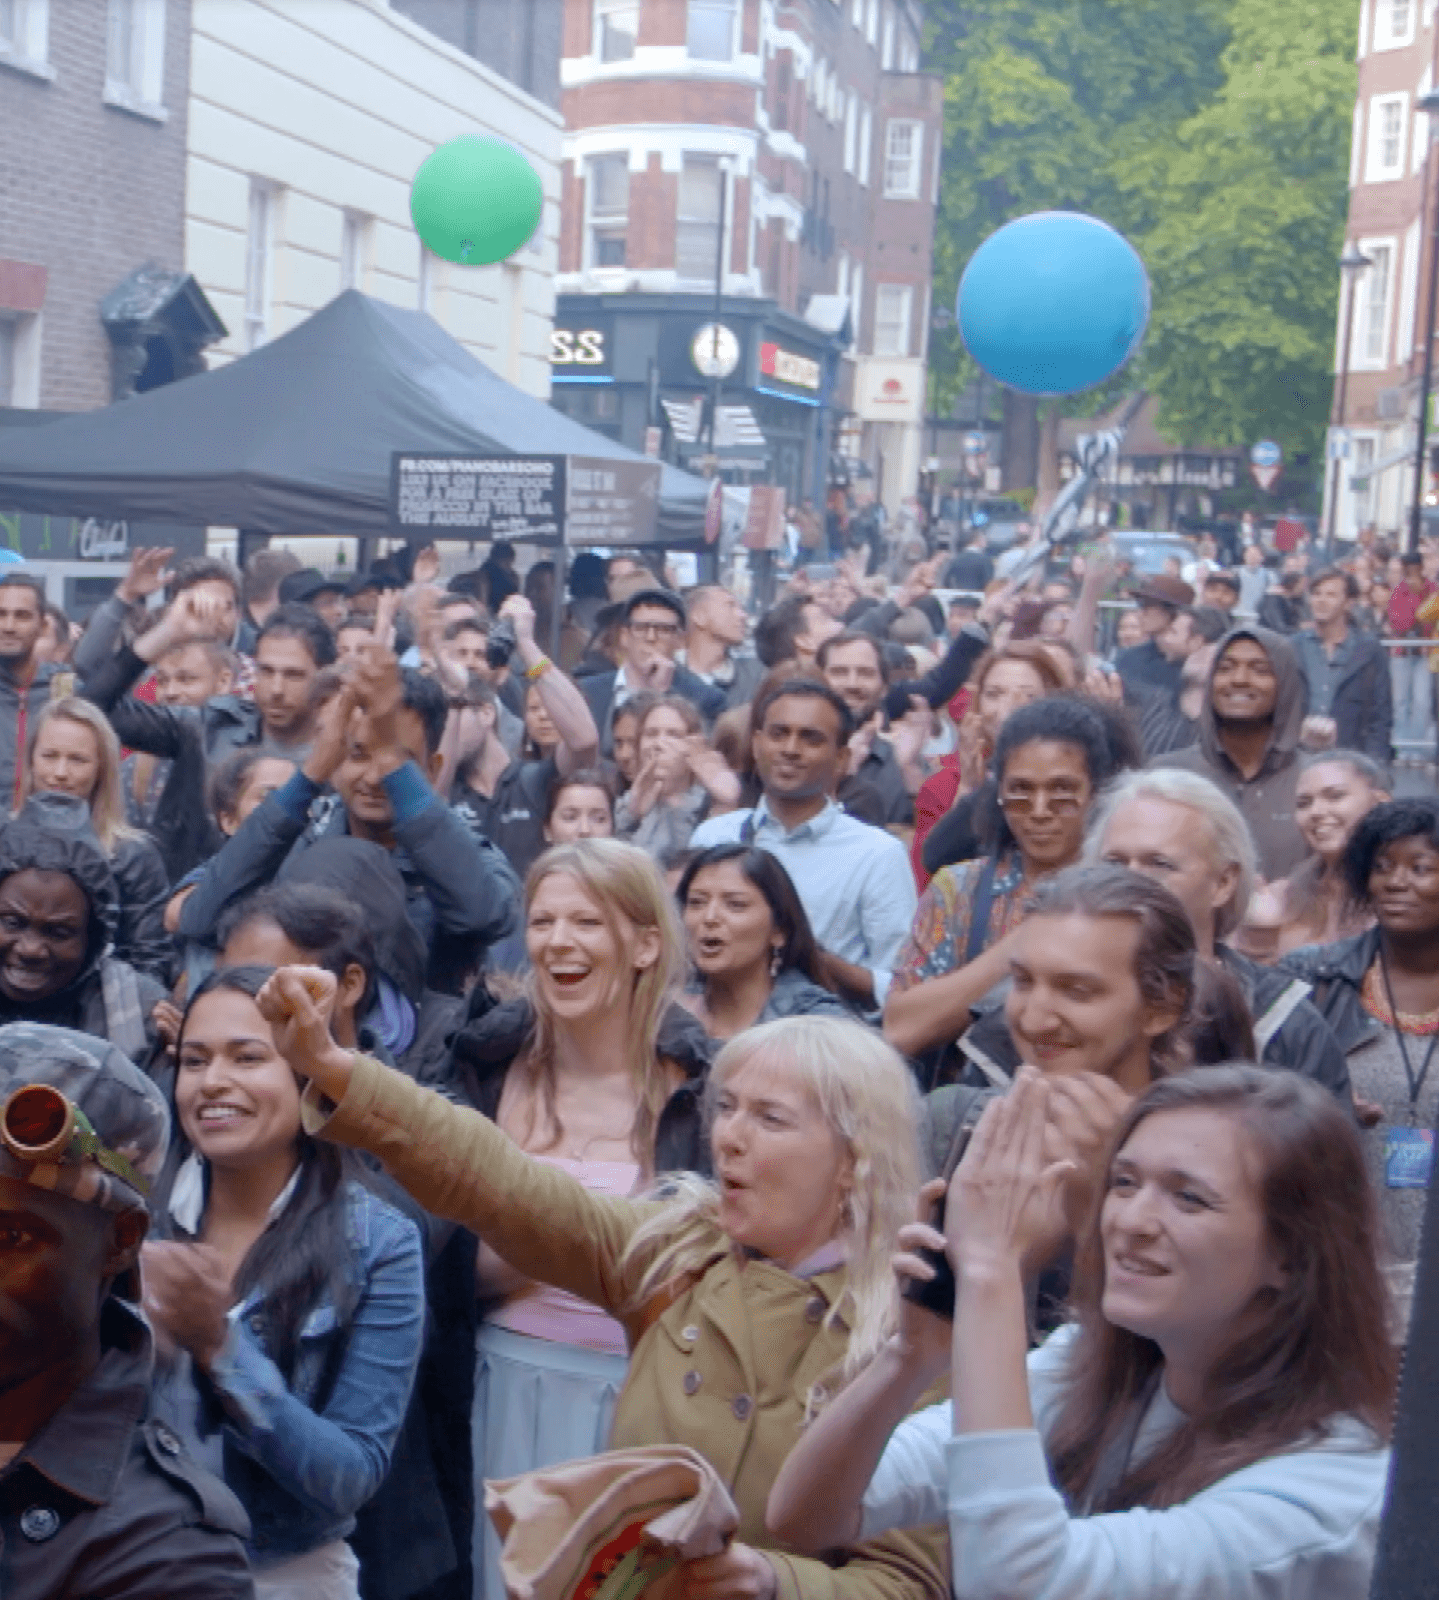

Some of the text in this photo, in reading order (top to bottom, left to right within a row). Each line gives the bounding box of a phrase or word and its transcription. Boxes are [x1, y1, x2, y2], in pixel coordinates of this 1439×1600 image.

[453, 475, 476, 488] ON
[522, 489, 543, 500] OF
[494, 502, 522, 514] THE
